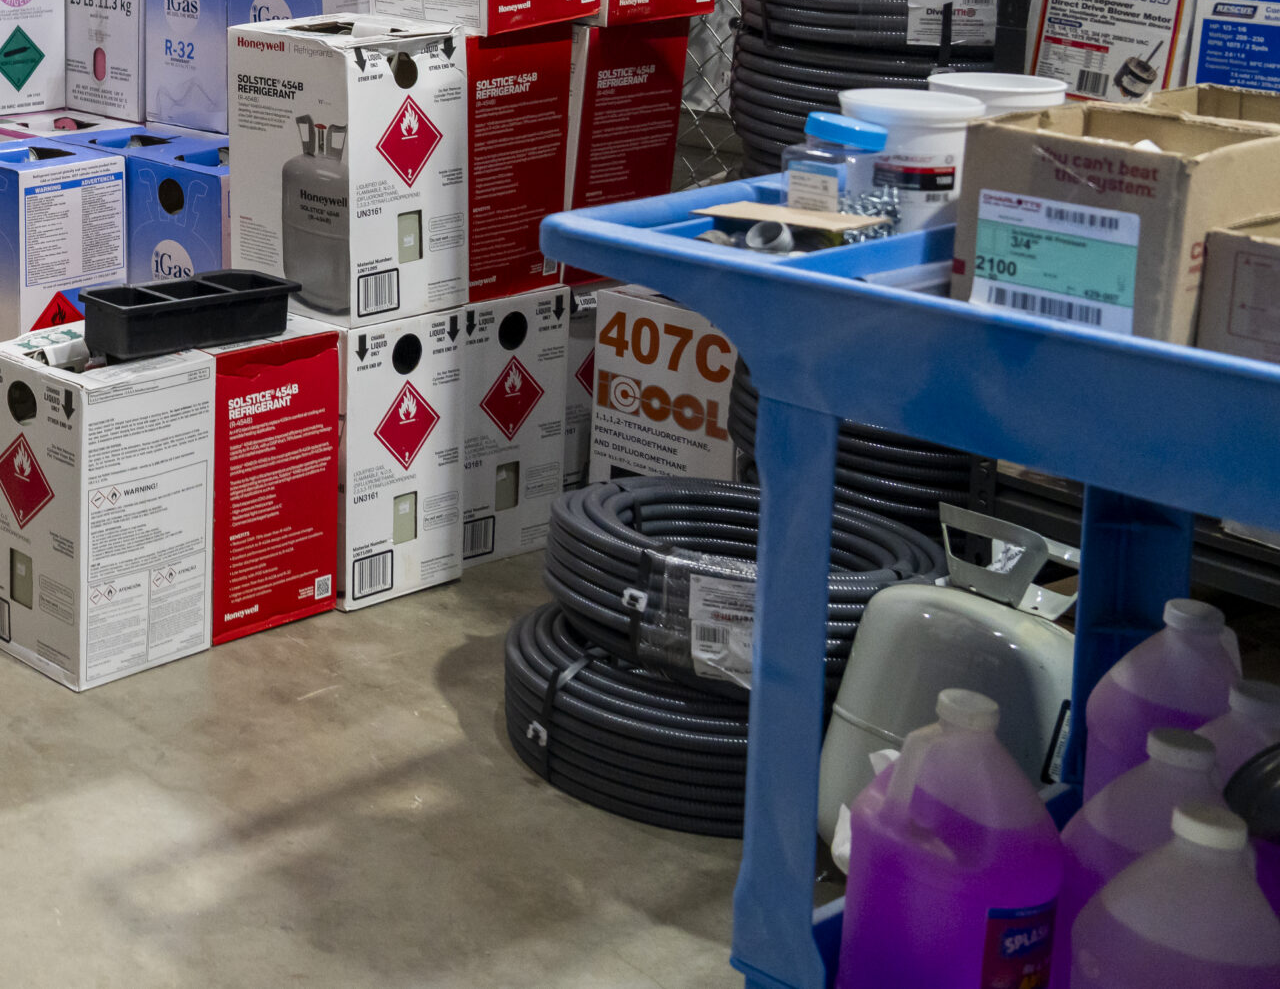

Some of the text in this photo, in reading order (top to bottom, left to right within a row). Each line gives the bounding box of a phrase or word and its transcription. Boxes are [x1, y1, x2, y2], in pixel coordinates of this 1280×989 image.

[499, 1, 531, 13] Honeywell
[1081, 3, 1105, 12] Drive
[1107, 7, 1141, 18] Blower
[1143, 13, 1172, 24] Motor
[1217, 3, 1256, 17] RESCUE
[164, 39, 195, 60] R-32
[238, 37, 333, 58] Honeywell Refrigerants
[636, 65, 655, 75] 454B
[517, 72, 537, 84] 454B
[597, 74, 648, 89] REFRIGERANT
[238, 85, 296, 100] REFRIGERANT
[282, 81, 304, 91] 454B
[476, 83, 530, 100] REFRIGERANT
[408, 169, 412, 178] 2
[1072, 155, 1159, 181] can't beat
[81, 175, 115, 185] ADVERTENCIA
[35, 185, 61, 193] WARNING
[300, 189, 348, 209] Honeywell
[357, 208, 382, 218] UN3161
[154, 253, 191, 279] iGas
[975, 255, 1017, 276] 2100
[580, 297, 596, 305] LIQUID
[599, 311, 733, 384] 407C
[276, 384, 298, 397] 454B
[44, 393, 60, 405] LIQUID
[229, 396, 291, 420] REFRIGERANT
[595, 412, 712, 452] 1,1,1,2-TETRAFLUOROETHANE,
[594, 425, 678, 456] PENTAFLUOROETHANE
[594, 438, 687, 472] AND DIFLUOROMETHANE
[124, 483, 158, 496] WARNING!
[353, 491, 378, 504] UN3161
[224, 604, 259, 621] Honeywell
